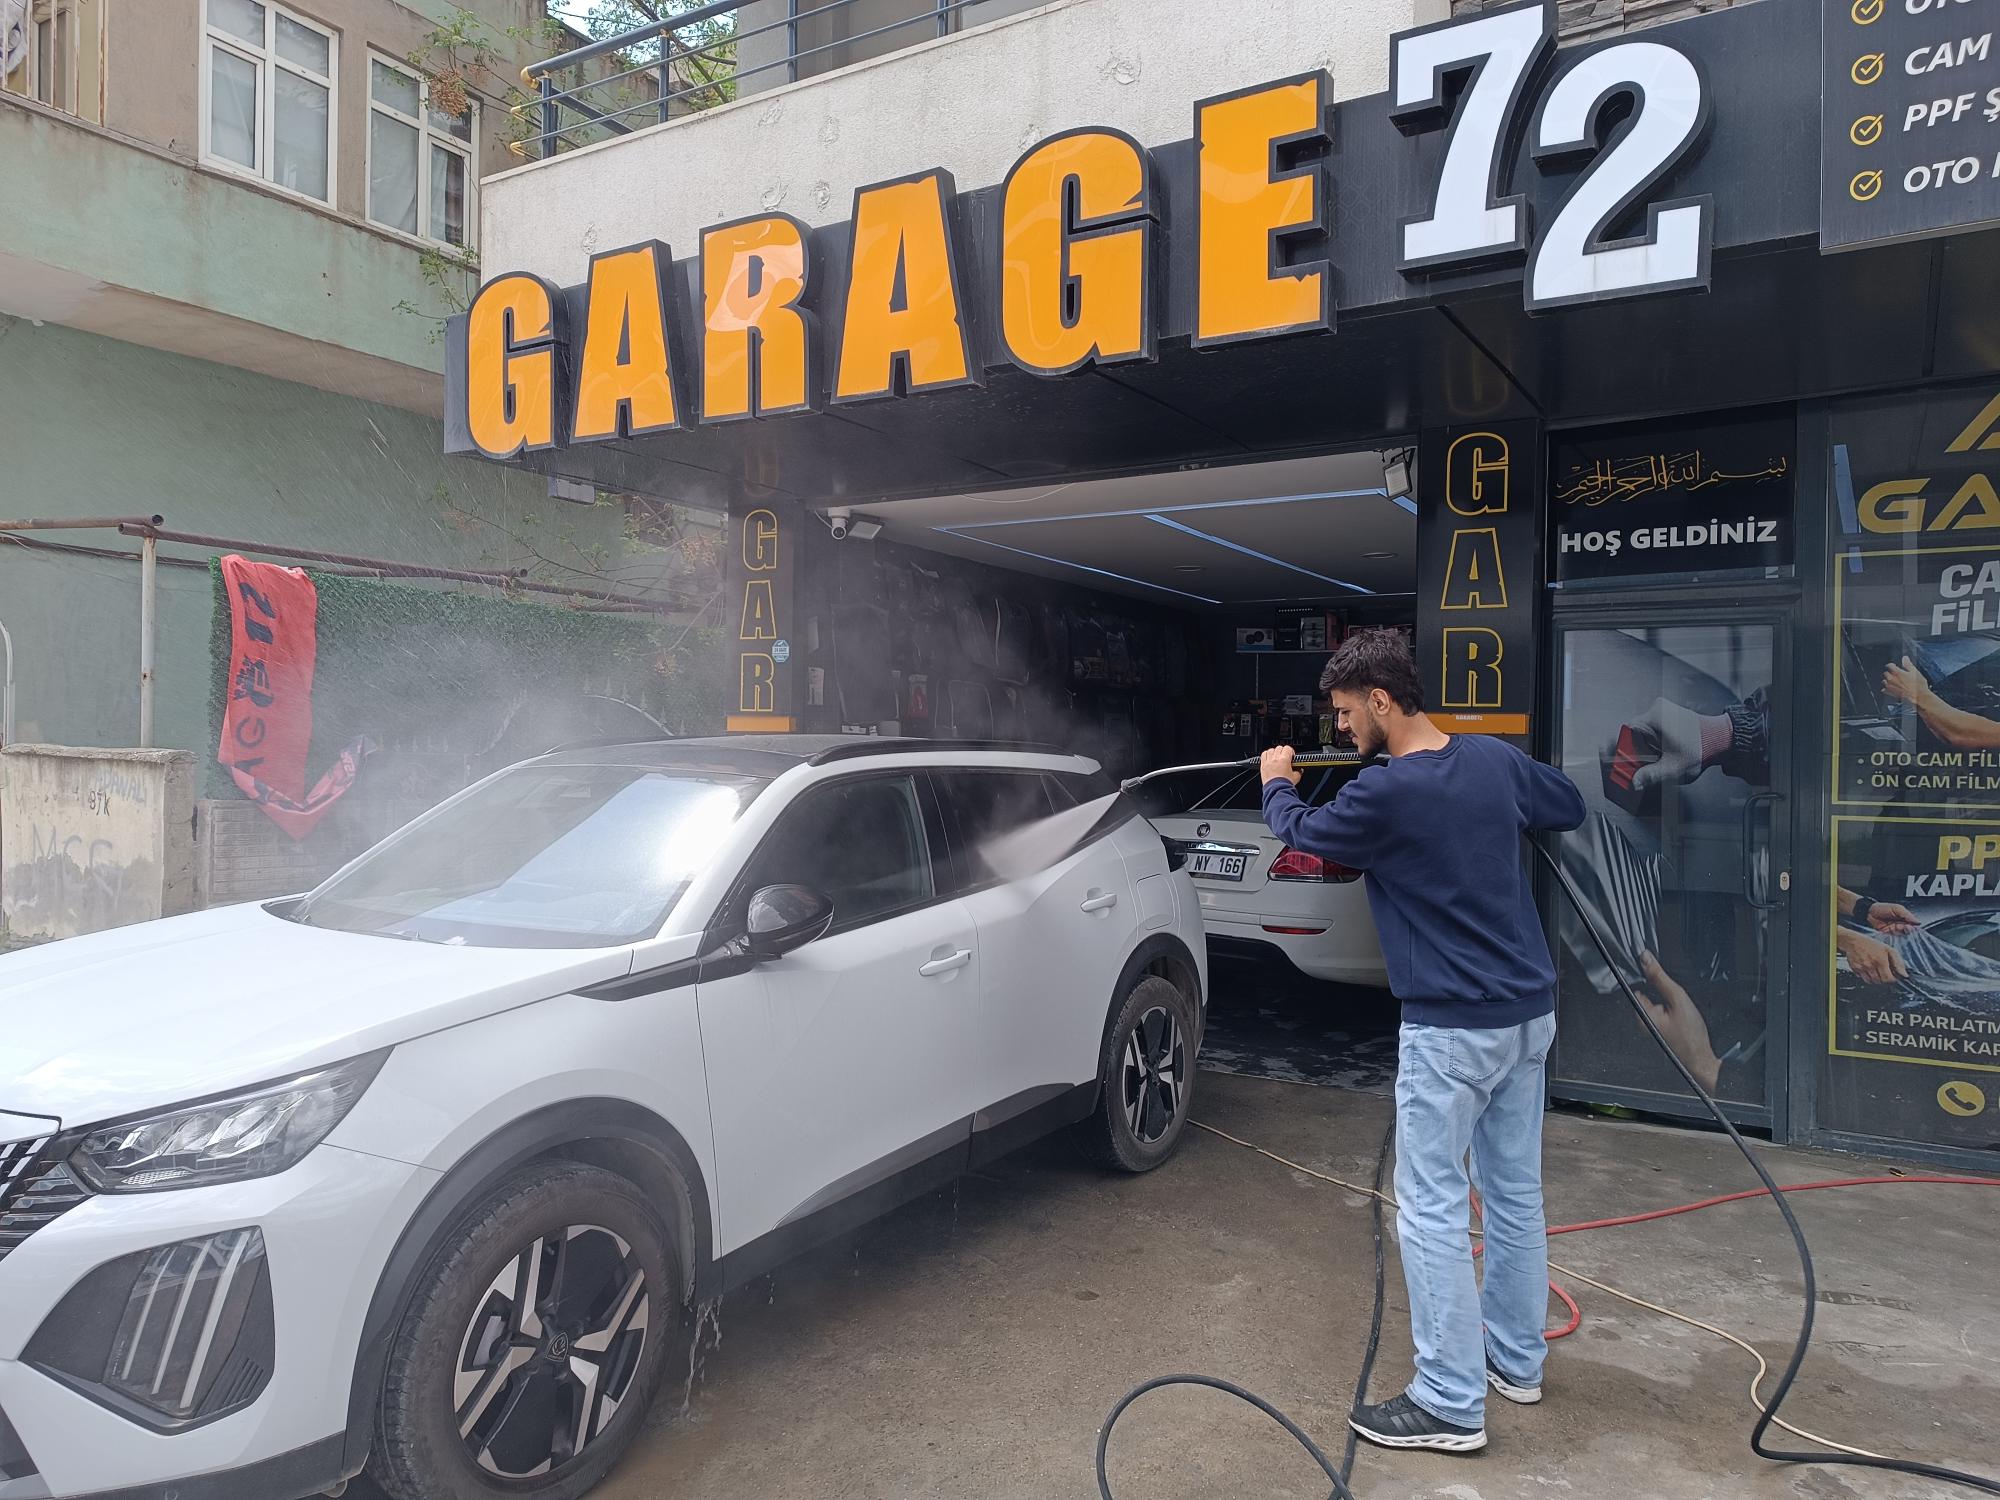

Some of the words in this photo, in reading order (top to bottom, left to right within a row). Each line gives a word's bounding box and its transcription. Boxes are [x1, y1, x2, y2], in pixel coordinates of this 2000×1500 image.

[1904, 32, 1993, 76] CAM
[1903, 91, 1977, 132] PPF
[1903, 156, 1980, 193] OTO
[466, 68, 1334, 458] GARAGE
[1391, 2, 1711, 314] 72
[1561, 530, 1622, 557] HOŞ
[1630, 515, 1777, 549] GELDİNİZ
[1440, 432, 1509, 708] GAR
[740, 509, 778, 712] GAR
[1931, 600, 2000, 636] FİL
[1871, 751, 1912, 766] OTO
[1916, 752, 1962, 767] CAM
[1968, 749, 2000, 768] FİL
[1871, 771, 1899, 788] ÖN
[1904, 775, 1950, 789] CAM
[1194, 855, 1212, 872] NY
[1219, 857, 1242, 874] 166
[1936, 834, 2000, 871] PP
[1905, 873, 2000, 898] KAPL
[1866, 1009, 1904, 1026] FAR
[1909, 1013, 2000, 1034] PARLATM
[1865, 1030, 1958, 1052] SERAMİK
